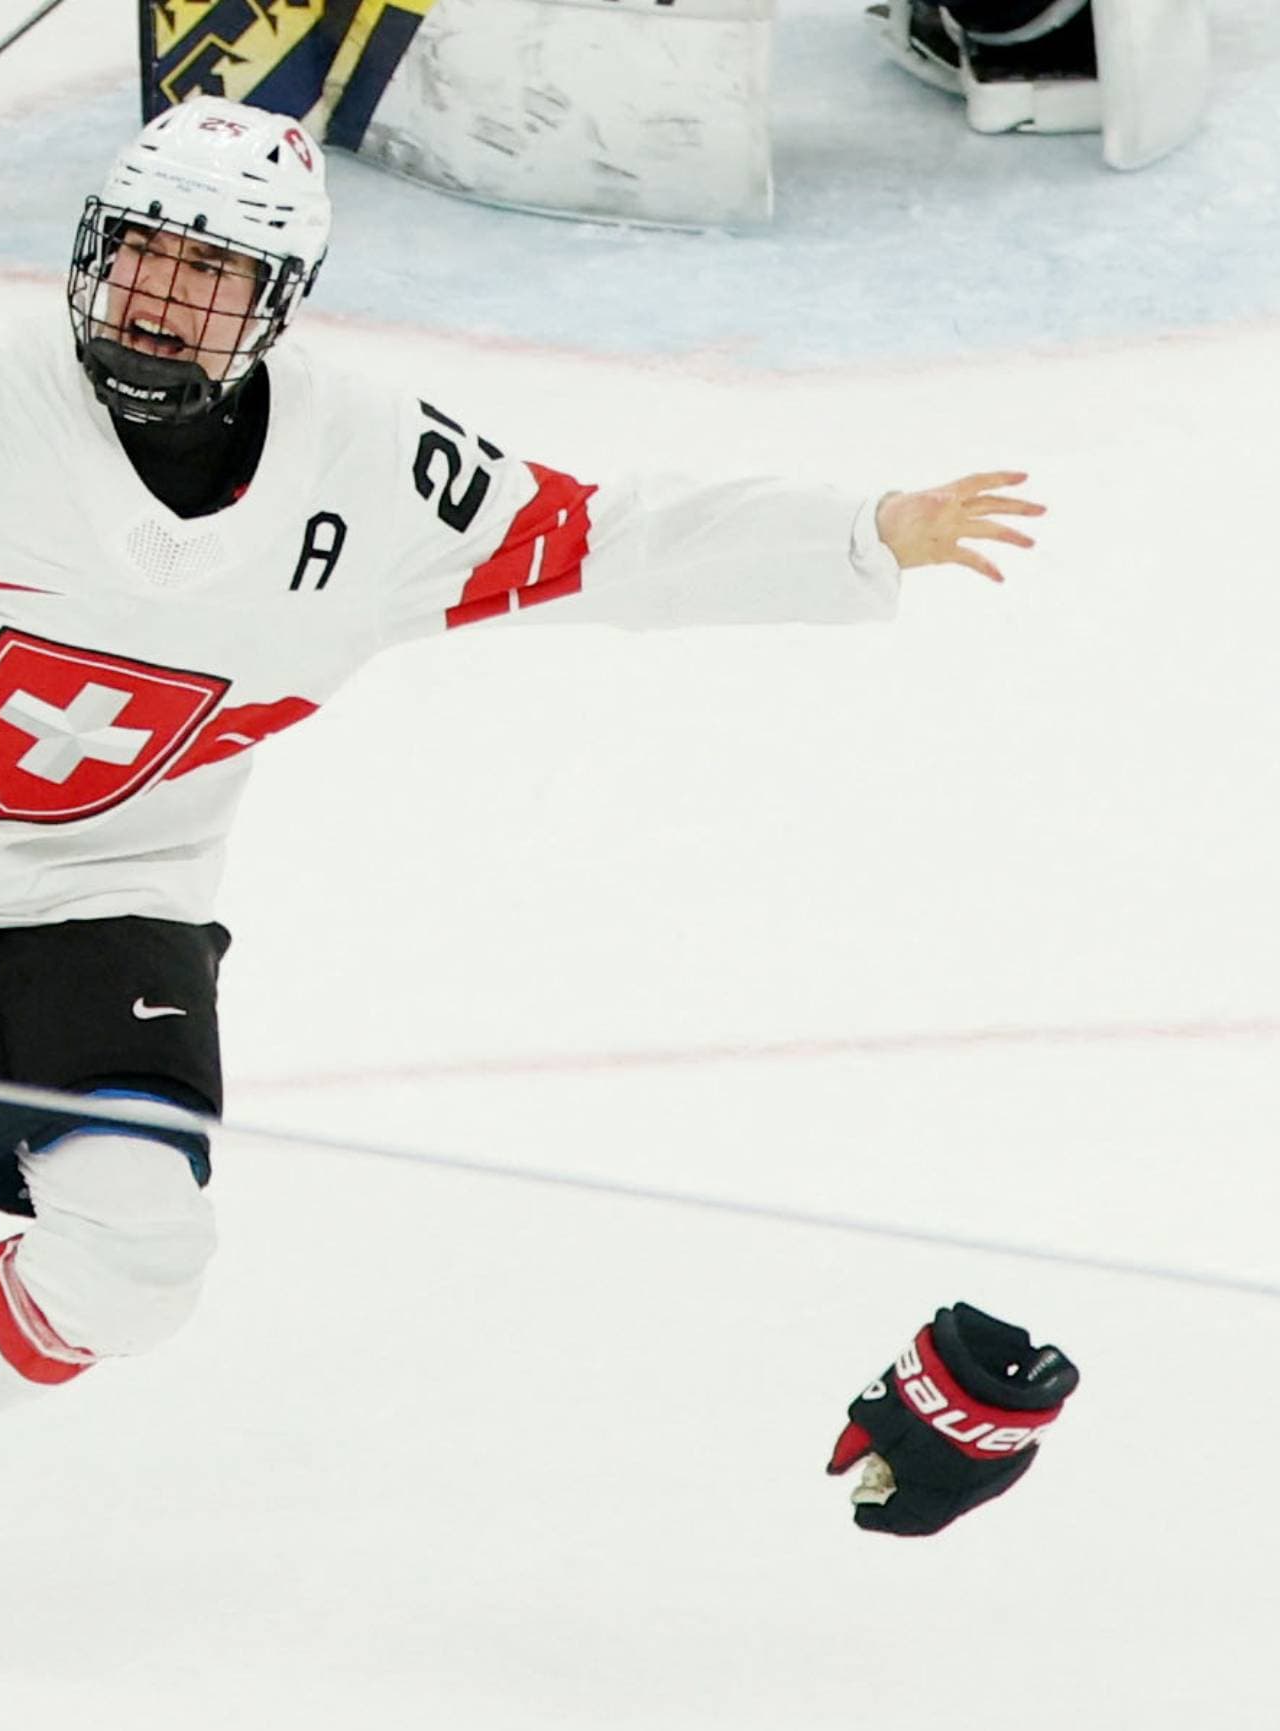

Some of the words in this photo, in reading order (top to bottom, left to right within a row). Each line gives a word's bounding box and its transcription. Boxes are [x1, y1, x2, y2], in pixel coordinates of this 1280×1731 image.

[200, 116, 249, 137] 25
[411, 398, 505, 534] 2
[289, 511, 347, 591] A
